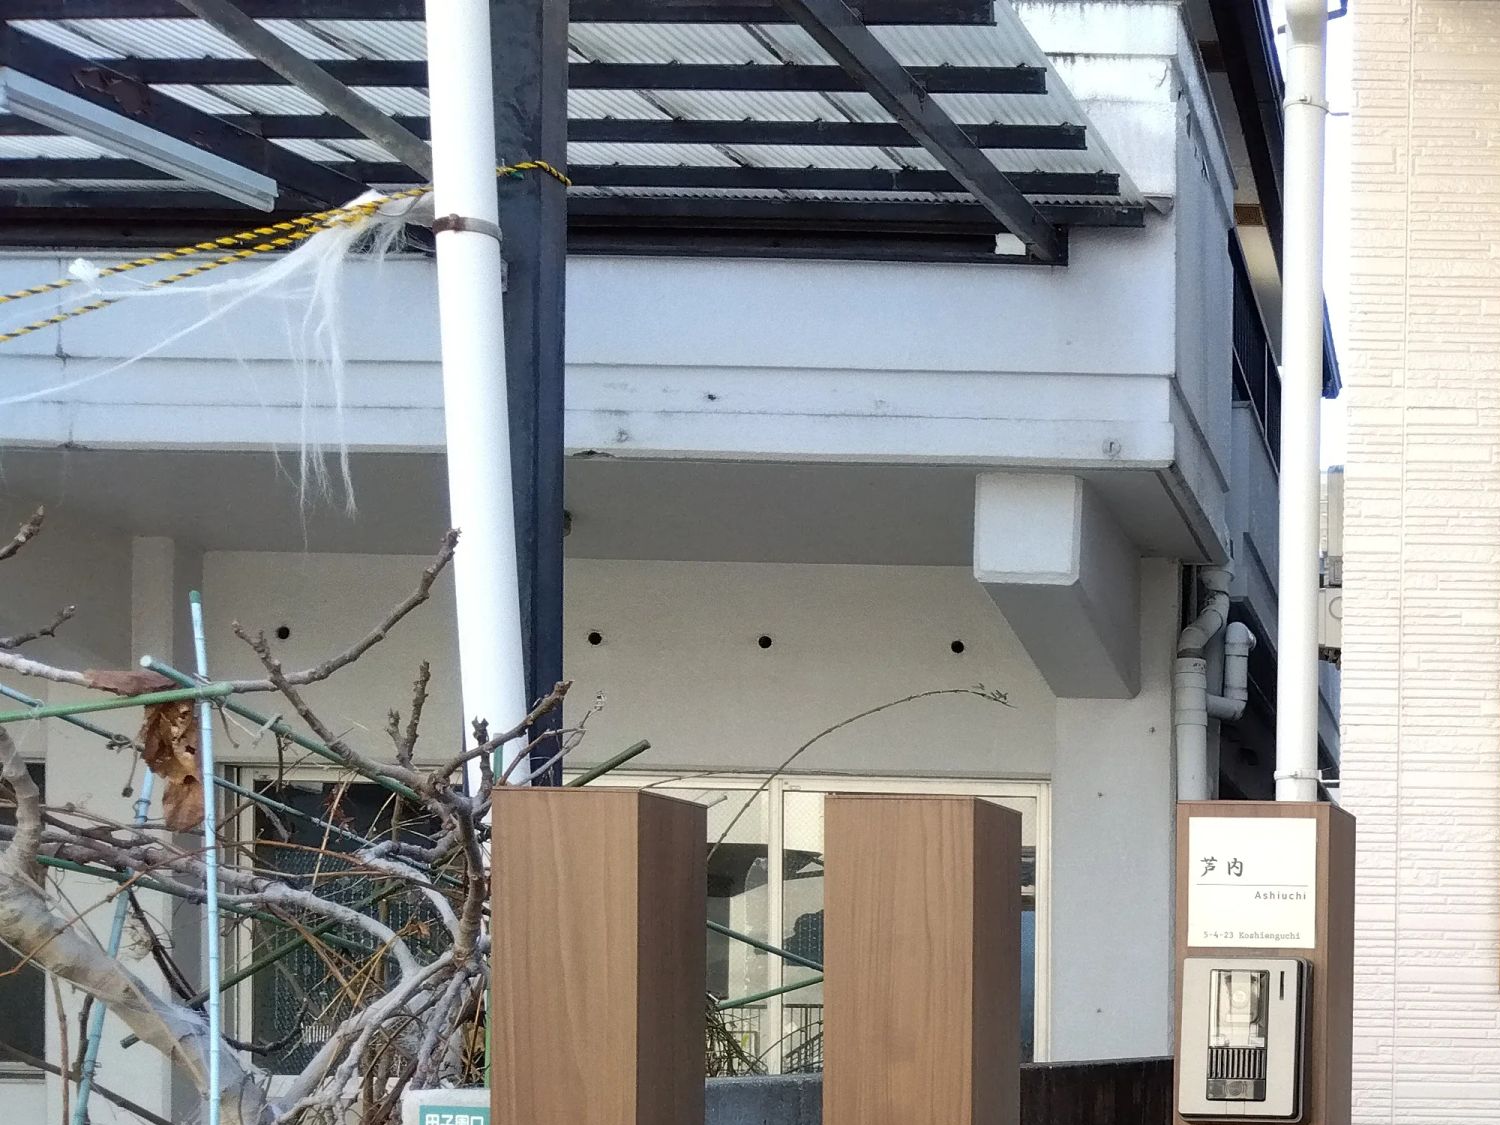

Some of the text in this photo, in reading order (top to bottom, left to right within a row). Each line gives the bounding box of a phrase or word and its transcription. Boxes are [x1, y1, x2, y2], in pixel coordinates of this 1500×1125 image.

[1254, 890, 1307, 901] Ashiuchi
[1203, 931, 1301, 941] 5-4-23 Koshienguchi
